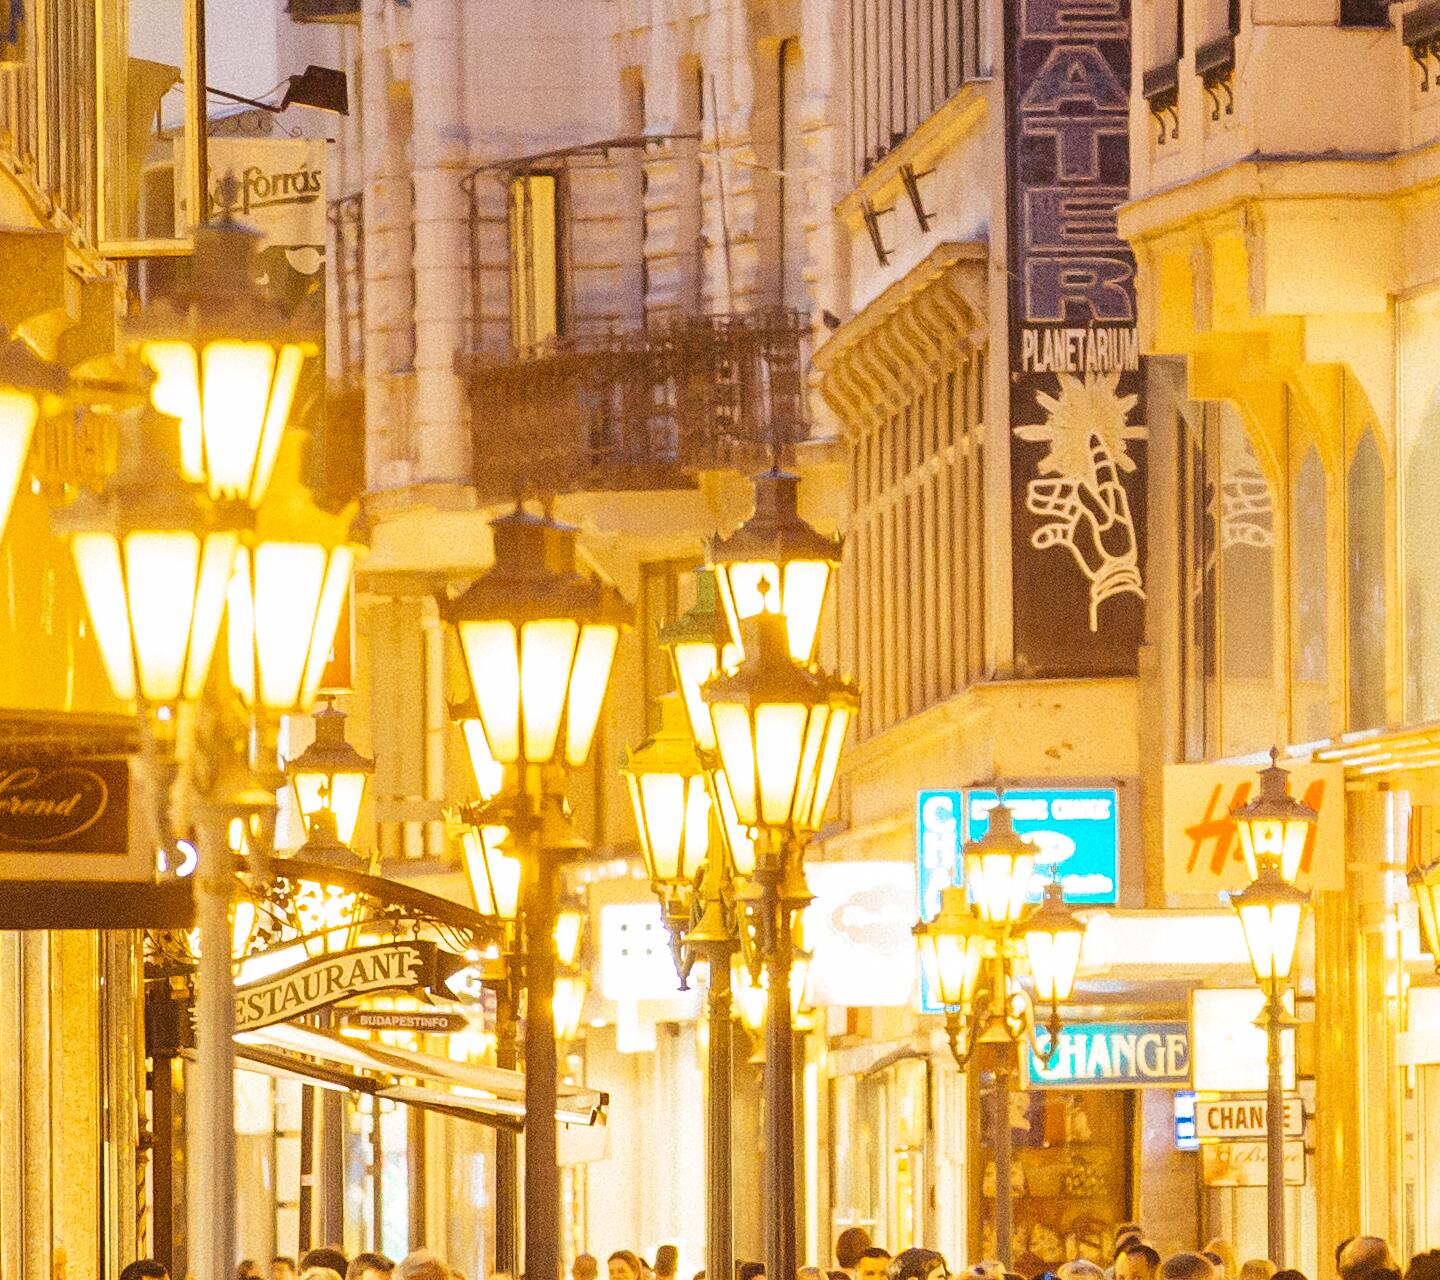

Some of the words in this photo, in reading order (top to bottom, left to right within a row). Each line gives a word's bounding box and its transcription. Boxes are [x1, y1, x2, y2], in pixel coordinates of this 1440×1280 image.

[1021, 323, 1141, 374] PLANETÁRIUM
[233, 950, 410, 1025] ESTAURANT
[359, 1014, 449, 1029] BUDAPESTINFO
[1031, 1031, 1190, 1081] CHANGE
[1207, 1105, 1293, 1131] CHANE
